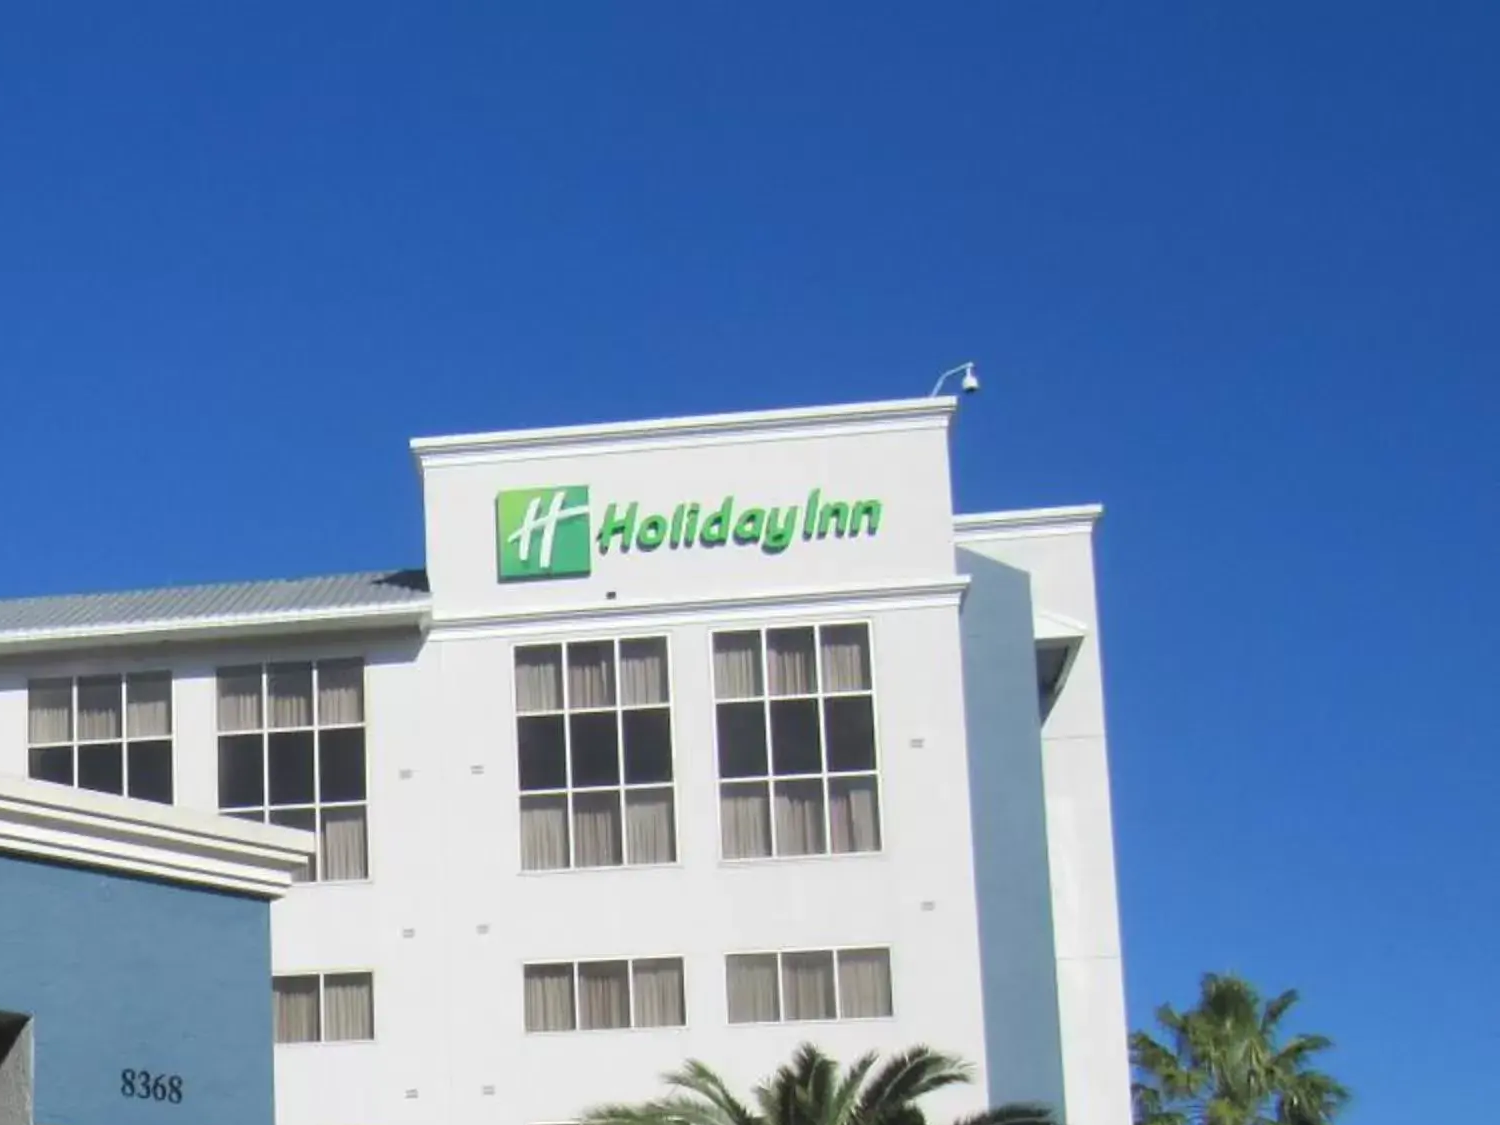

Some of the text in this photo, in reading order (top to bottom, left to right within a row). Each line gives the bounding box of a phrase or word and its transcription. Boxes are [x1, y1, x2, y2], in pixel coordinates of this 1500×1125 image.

[596, 487, 882, 556] Holiday Inn
[120, 1067, 183, 1105] 8368
